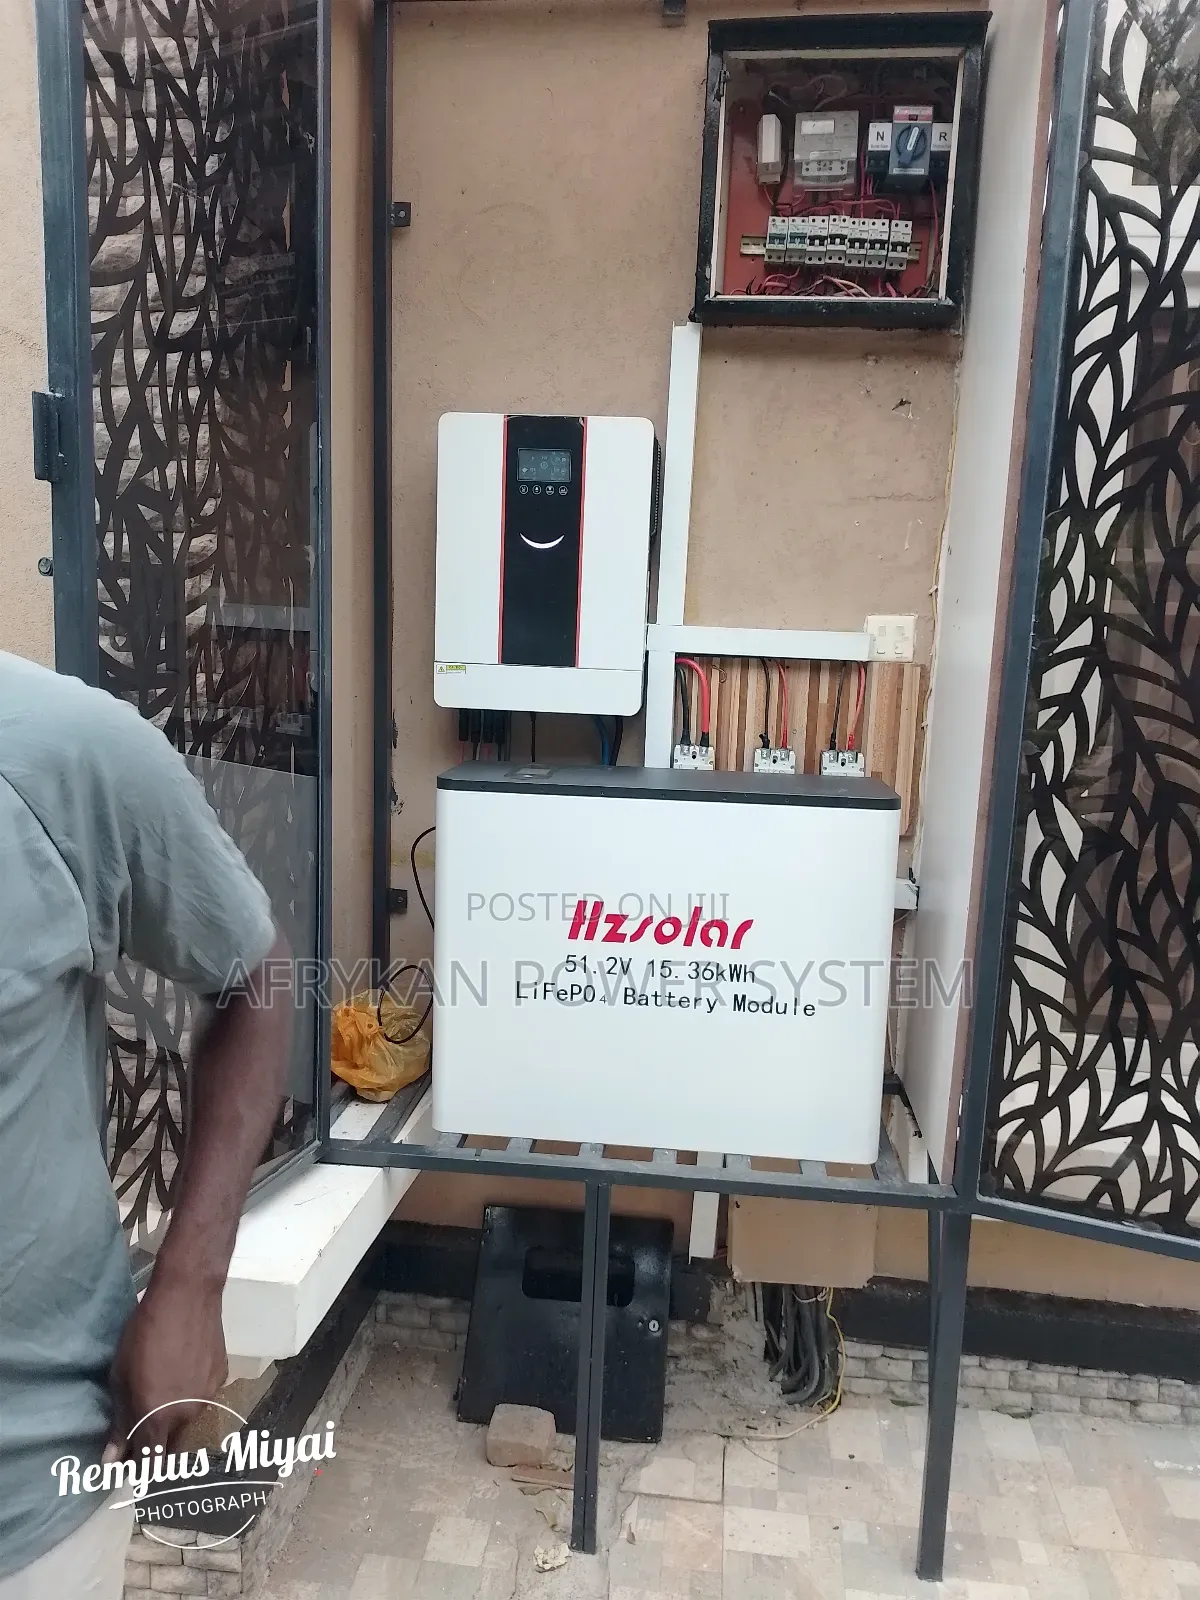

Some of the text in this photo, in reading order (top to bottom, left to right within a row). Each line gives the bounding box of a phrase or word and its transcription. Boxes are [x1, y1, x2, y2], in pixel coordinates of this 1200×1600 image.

[876, 130, 885, 141] N
[939, 131, 948, 141] R
[567, 900, 754, 949] Hzsolar
[564, 954, 755, 983] 51.2V 15.36kWh
[623, 987, 719, 1013] Battery
[733, 993, 816, 1016] Module
